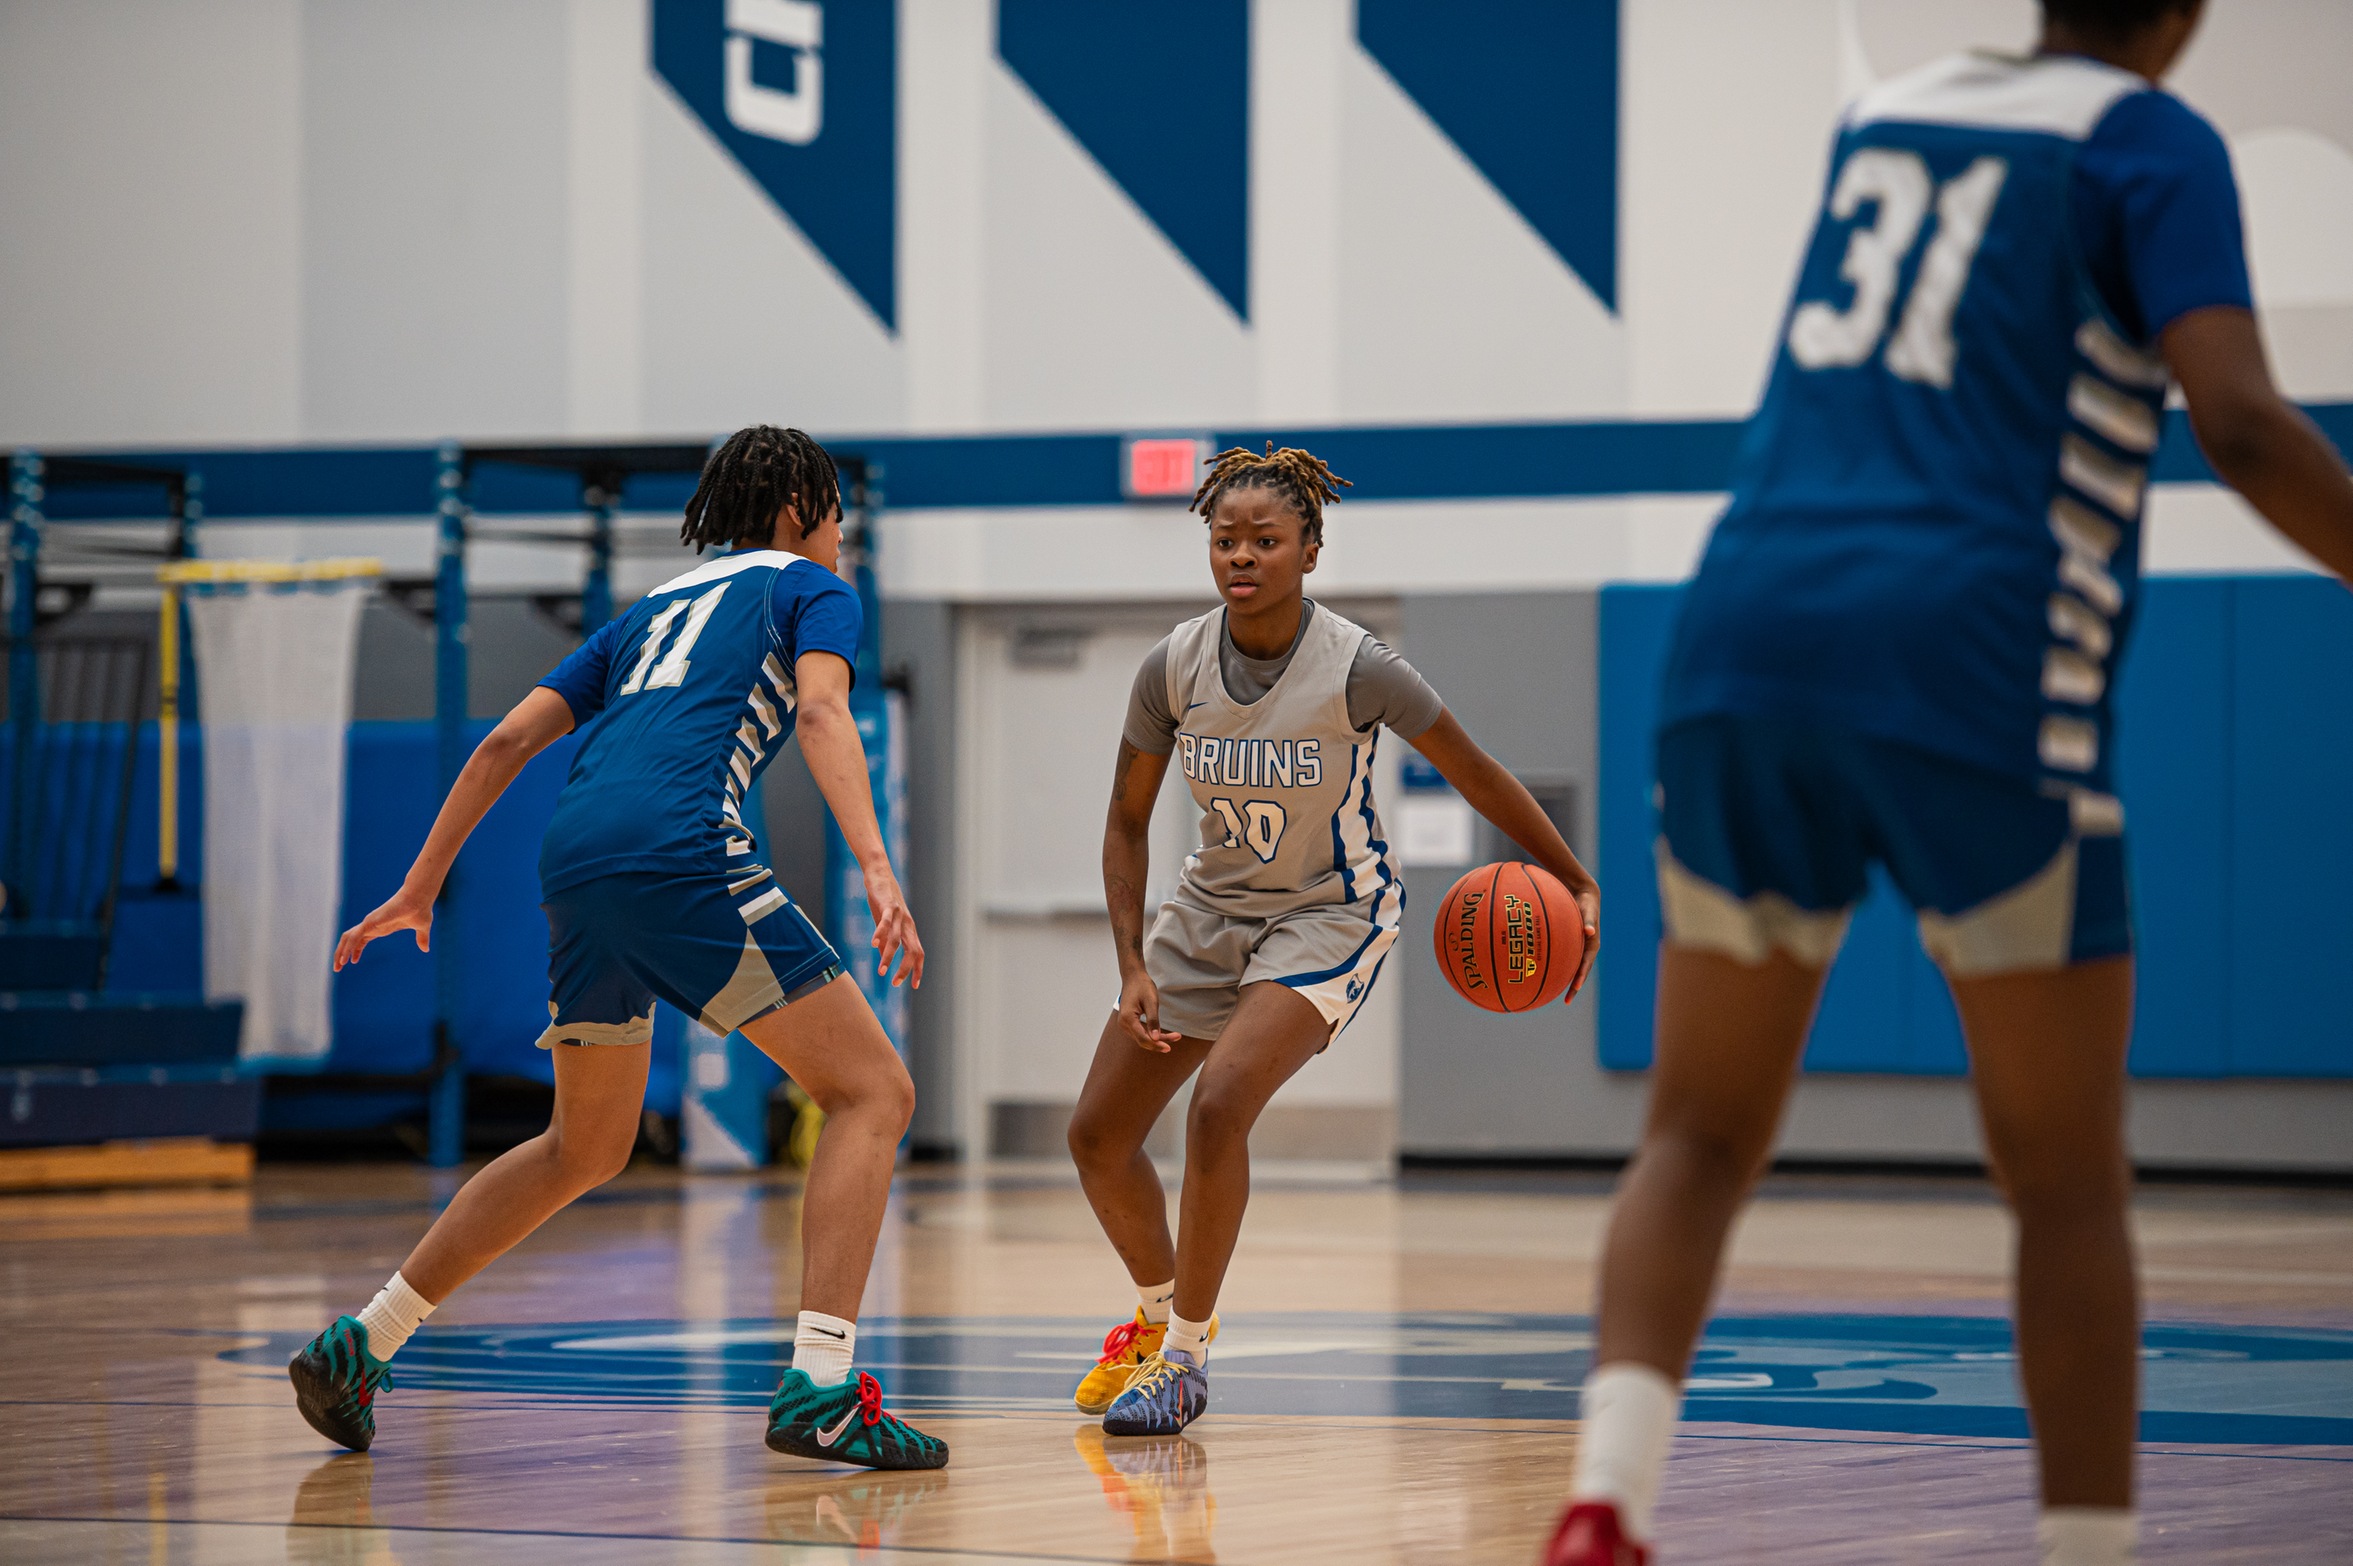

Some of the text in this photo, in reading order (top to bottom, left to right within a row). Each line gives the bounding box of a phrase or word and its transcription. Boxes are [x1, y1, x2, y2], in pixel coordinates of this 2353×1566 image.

[1788, 147, 2009, 391] 31
[620, 581, 733, 696] 11
[1179, 732, 1323, 788] BRUINS
[1210, 797, 1287, 865] 10
[1460, 892, 1488, 989] SPALDING
[1504, 895, 1524, 984] LEGACY
[1524, 902, 1534, 956] 1000
